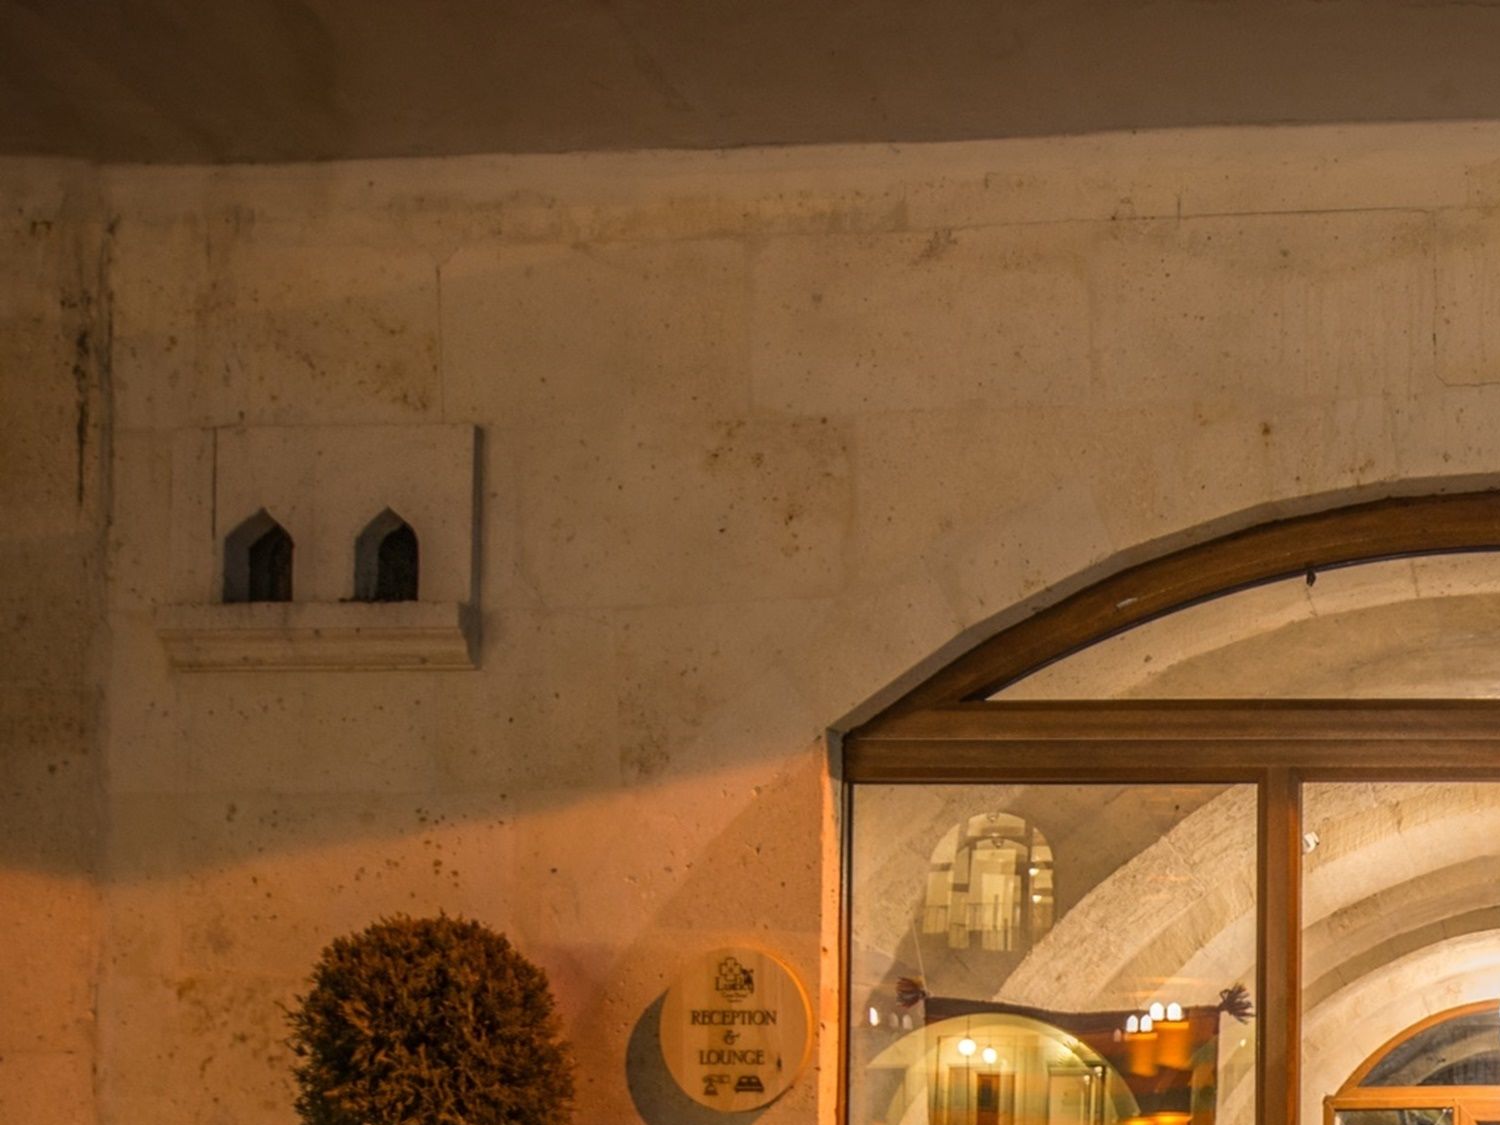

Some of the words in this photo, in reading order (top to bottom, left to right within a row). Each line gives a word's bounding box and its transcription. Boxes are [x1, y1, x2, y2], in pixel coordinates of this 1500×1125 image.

[691, 1010, 777, 1025] RECEPTION
[723, 1029, 740, 1045] &
[699, 1049, 765, 1065] LOUNGE
